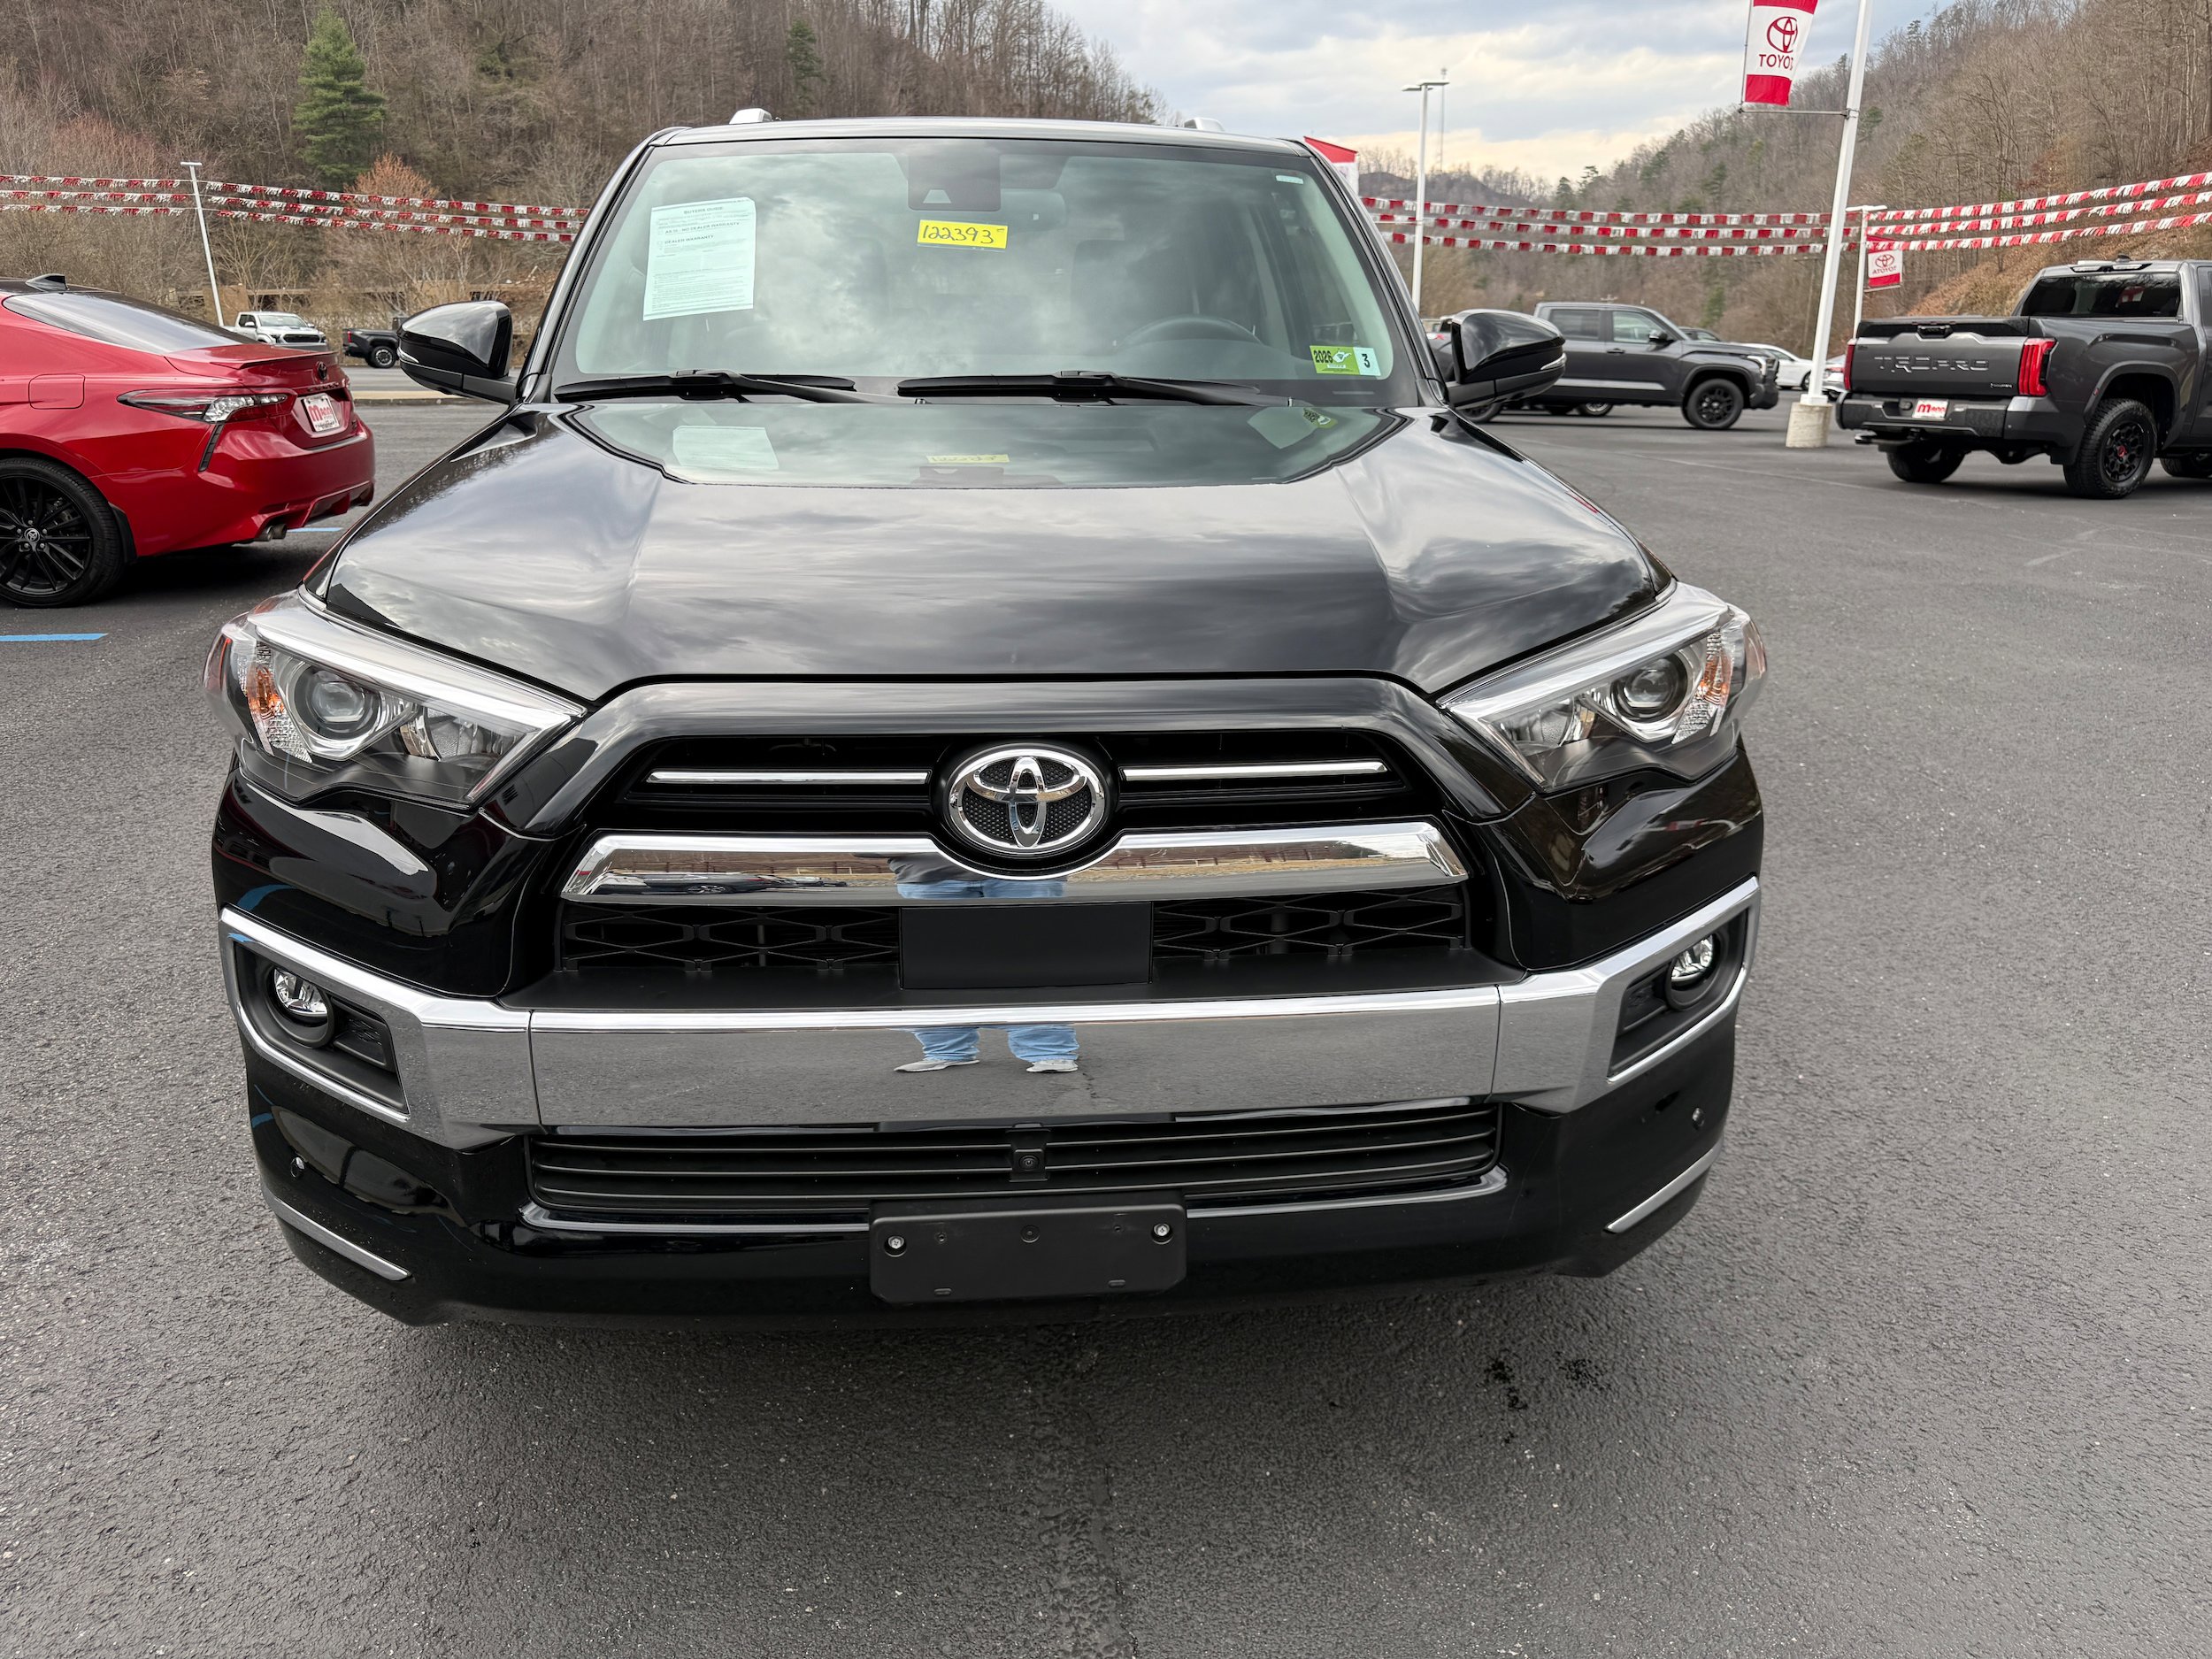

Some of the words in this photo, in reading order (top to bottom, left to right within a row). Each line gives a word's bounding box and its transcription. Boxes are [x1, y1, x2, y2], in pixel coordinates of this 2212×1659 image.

[1759, 54, 1793, 71] TOYO
[923, 225, 994, 244] 122393
[1361, 353, 1371, 368] 3
